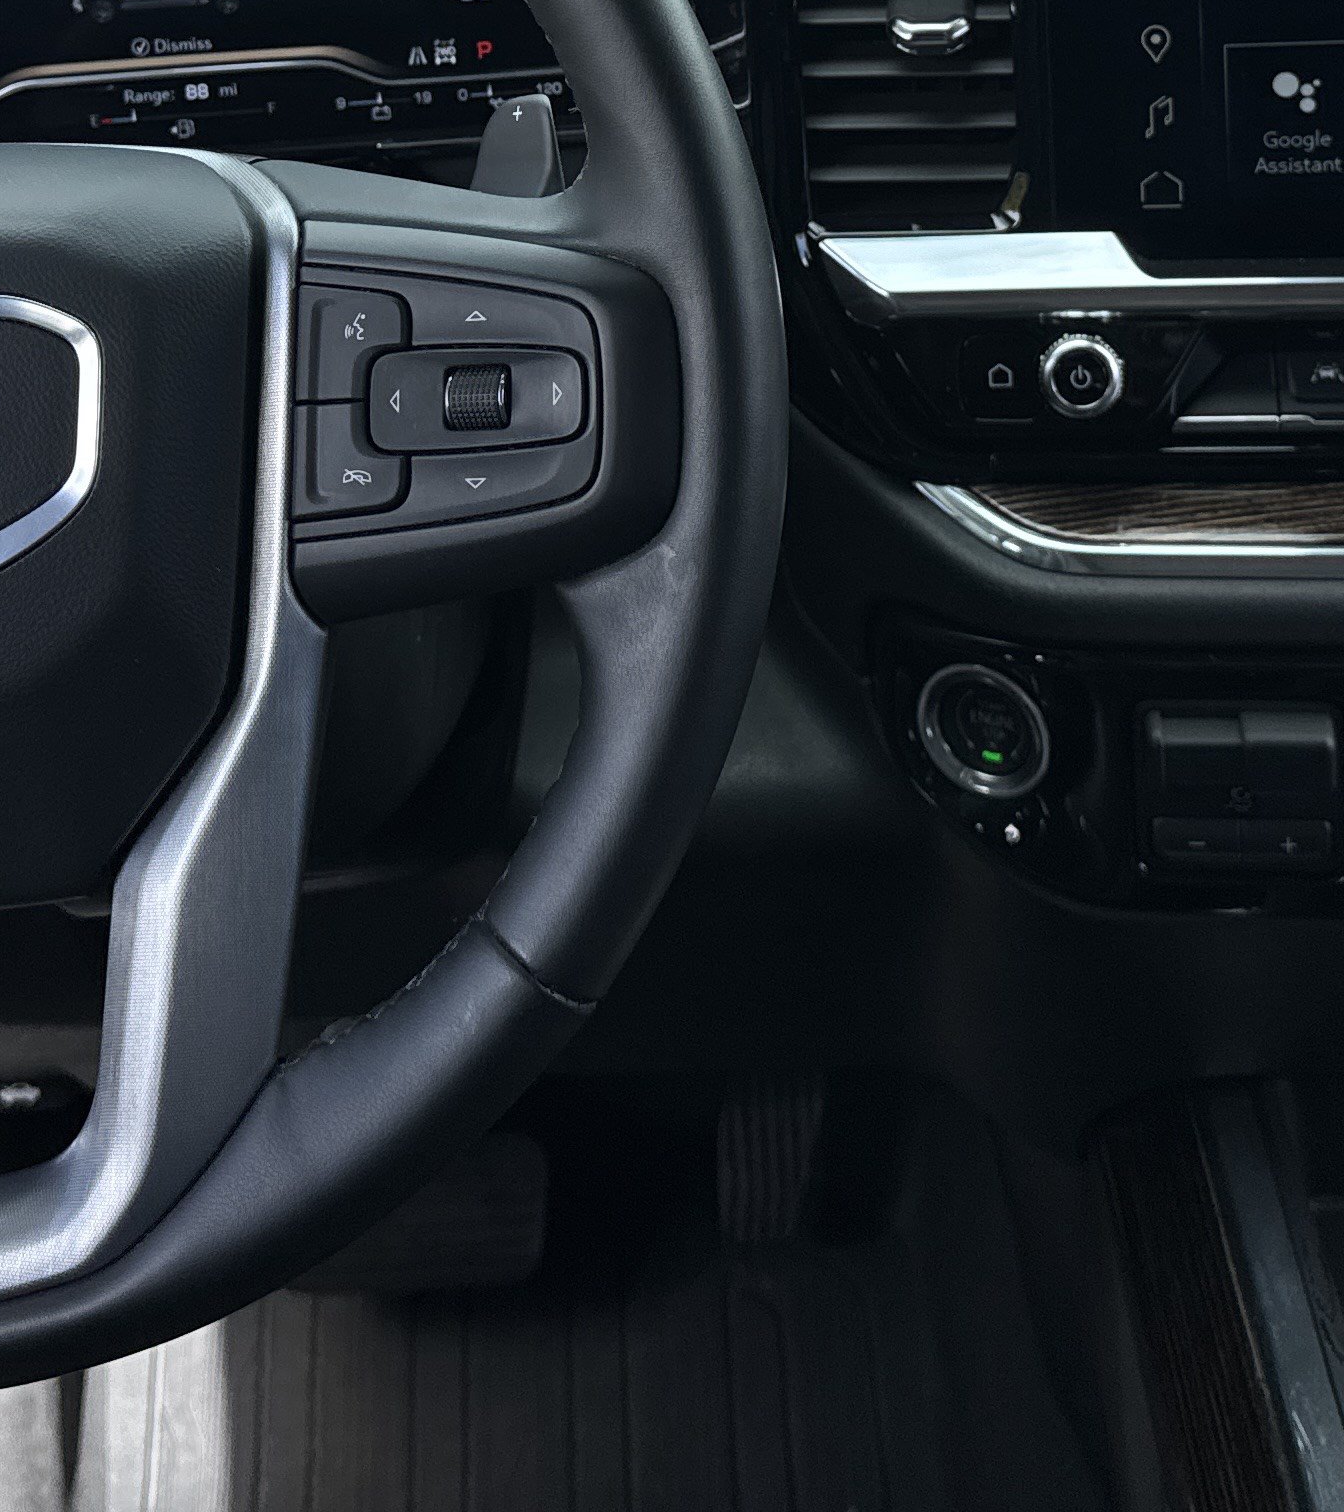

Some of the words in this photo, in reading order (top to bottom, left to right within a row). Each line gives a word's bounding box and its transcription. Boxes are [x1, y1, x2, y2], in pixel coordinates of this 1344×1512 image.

[154, 36, 213, 54] Dismiss
[476, 39, 494, 59] P
[123, 87, 175, 105] Range:
[184, 83, 209, 100] 88
[219, 83, 238, 99] mi
[1263, 129, 1332, 154] Google
[1254, 155, 1342, 175] Assistant
